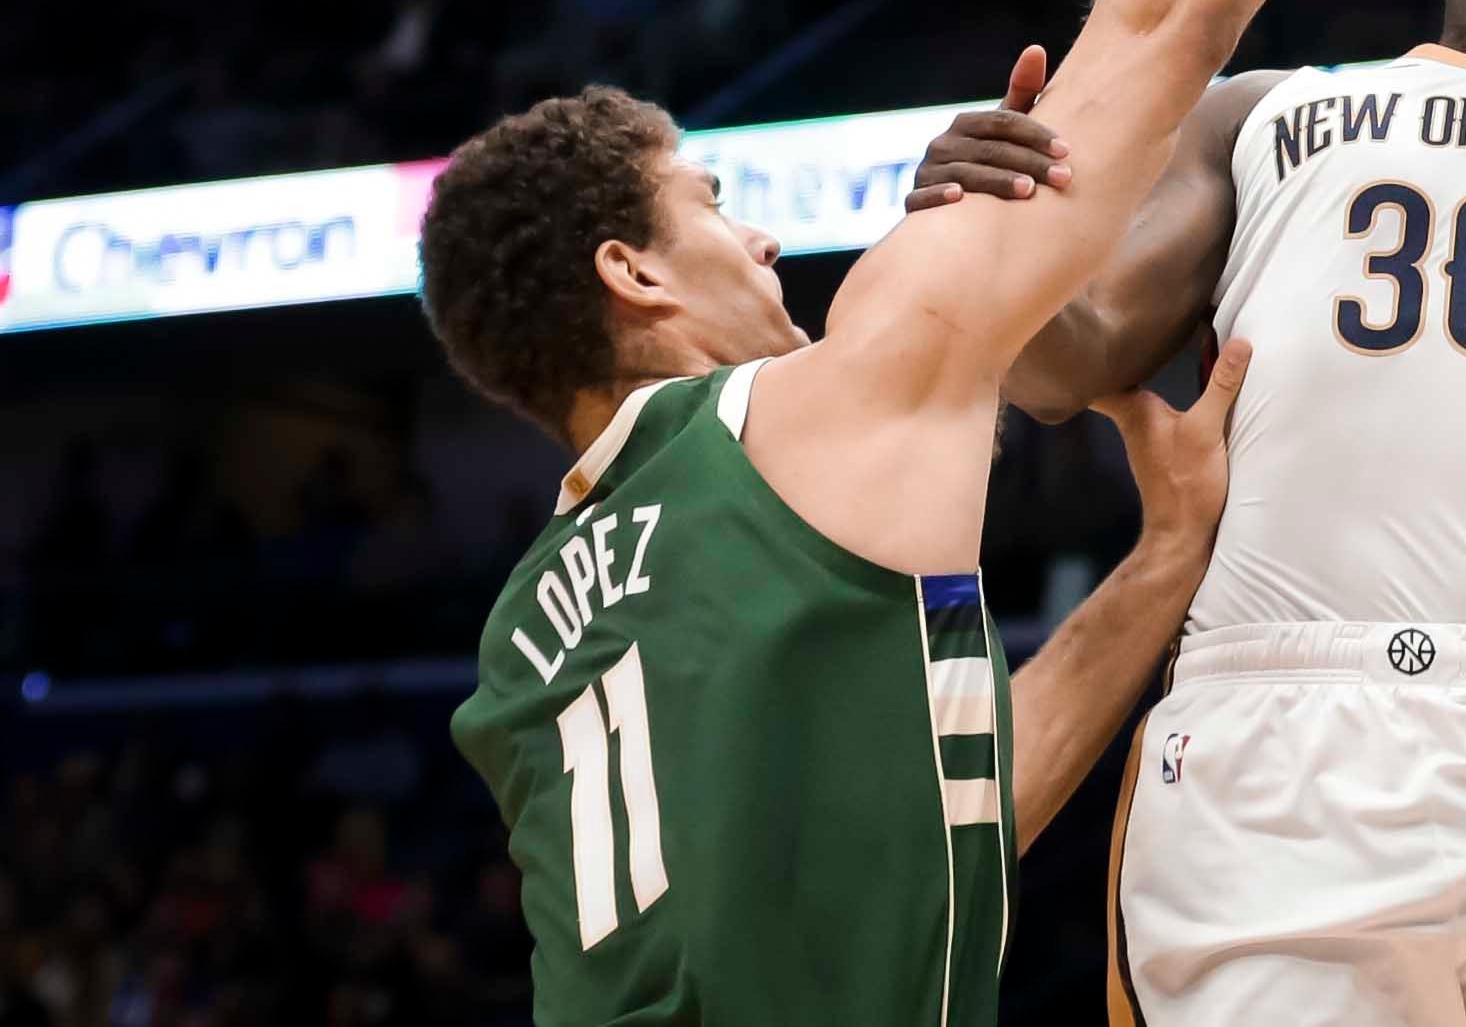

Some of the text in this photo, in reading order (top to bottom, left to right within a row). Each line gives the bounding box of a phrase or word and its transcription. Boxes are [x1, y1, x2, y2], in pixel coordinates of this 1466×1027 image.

[1272, 92, 1402, 183] NEW
[51, 214, 357, 293] Chevron
[511, 503, 662, 686] LOPEZ
[556, 640, 670, 952] 11
